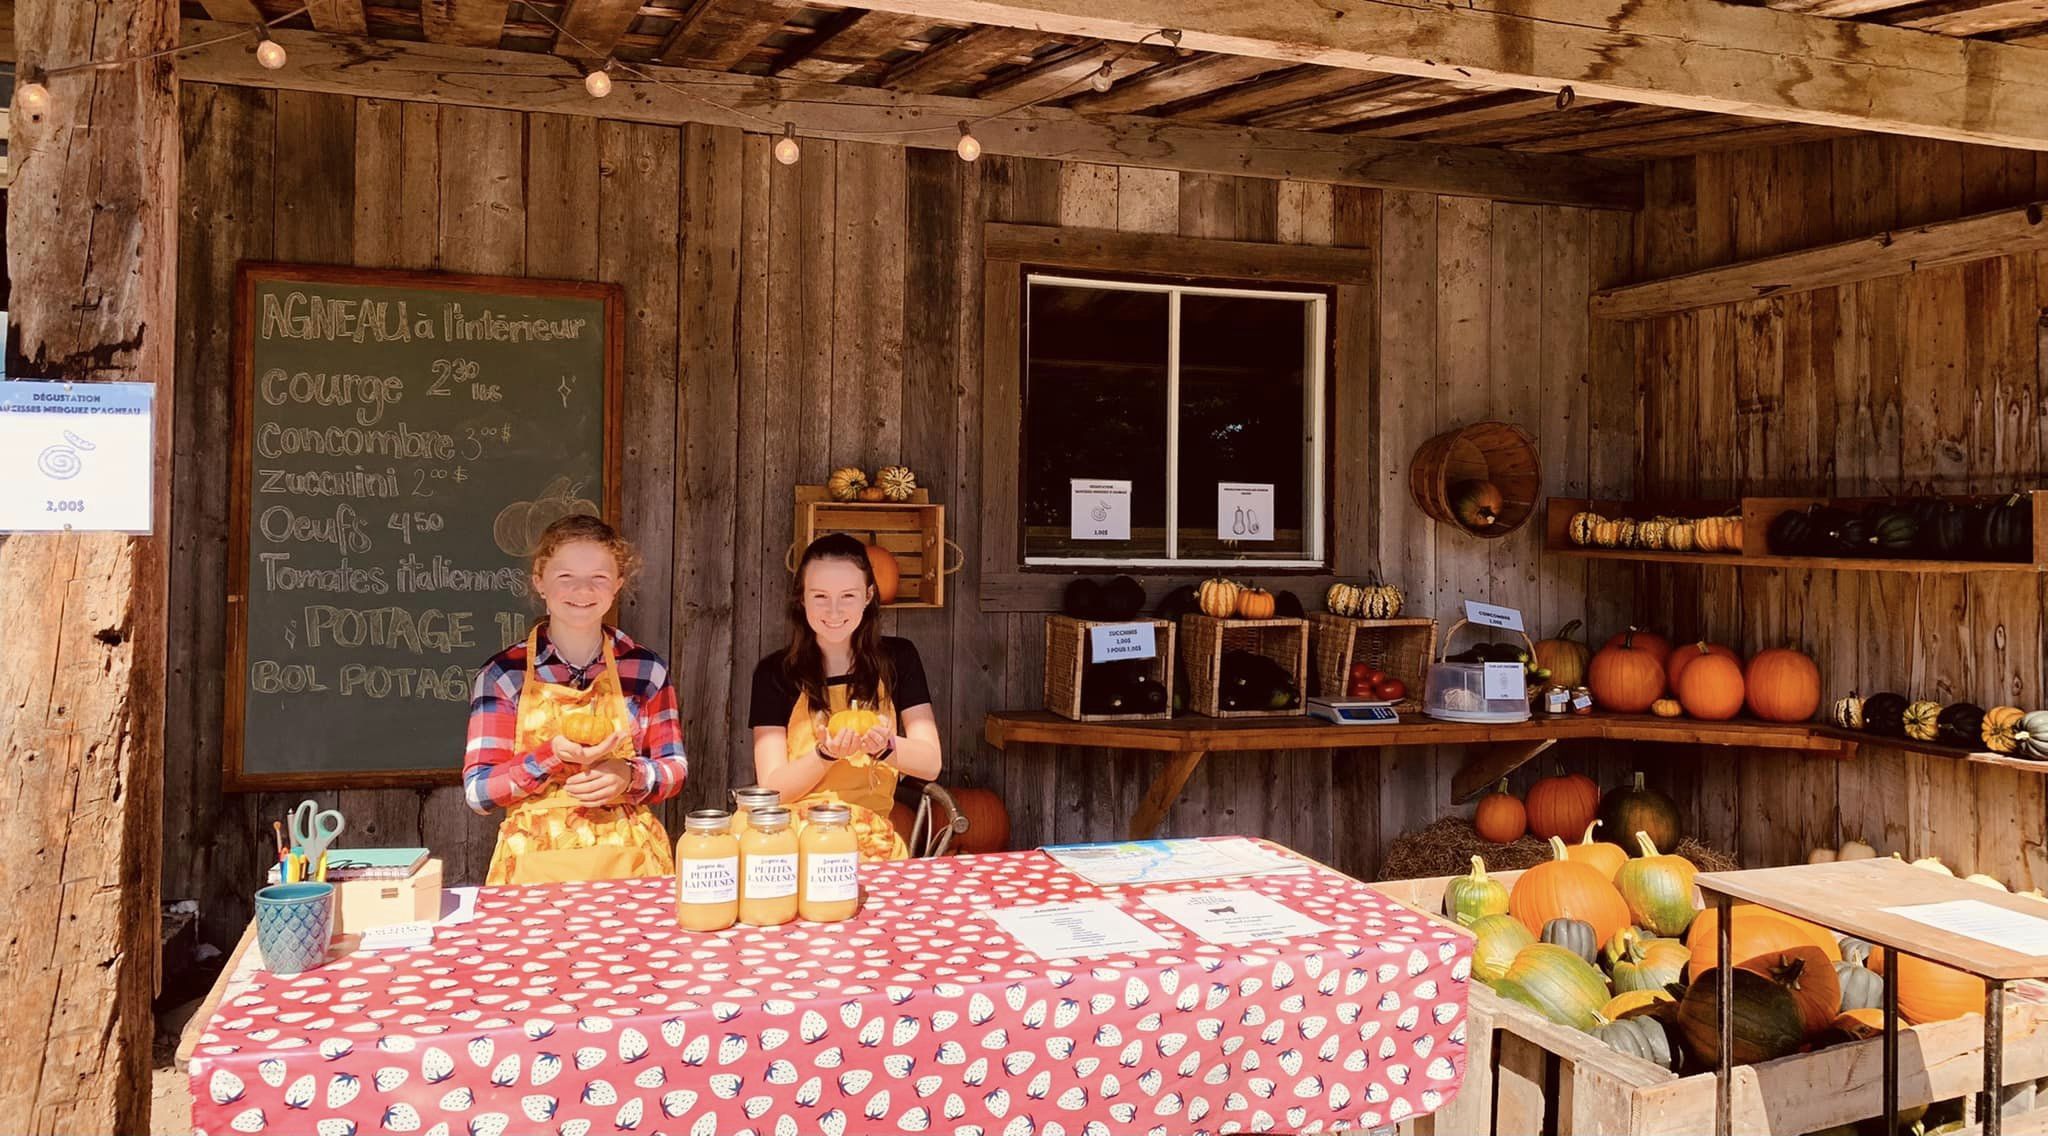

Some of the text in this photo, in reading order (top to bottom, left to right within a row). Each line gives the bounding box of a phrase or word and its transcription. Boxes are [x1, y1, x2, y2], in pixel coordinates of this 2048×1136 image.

[261, 291, 587, 344] AGNEAU à l'intérieur
[32, 392, 102, 403] DÉGUSTATION
[43, 405, 89, 414] MERGUEZ
[90, 406, 141, 415] D'AGNEAU
[46, 499, 86, 513] 2,00$
[259, 551, 529, 599] Tomates italiennes
[303, 604, 476, 654] POTAGE
[251, 659, 328, 694] BOL
